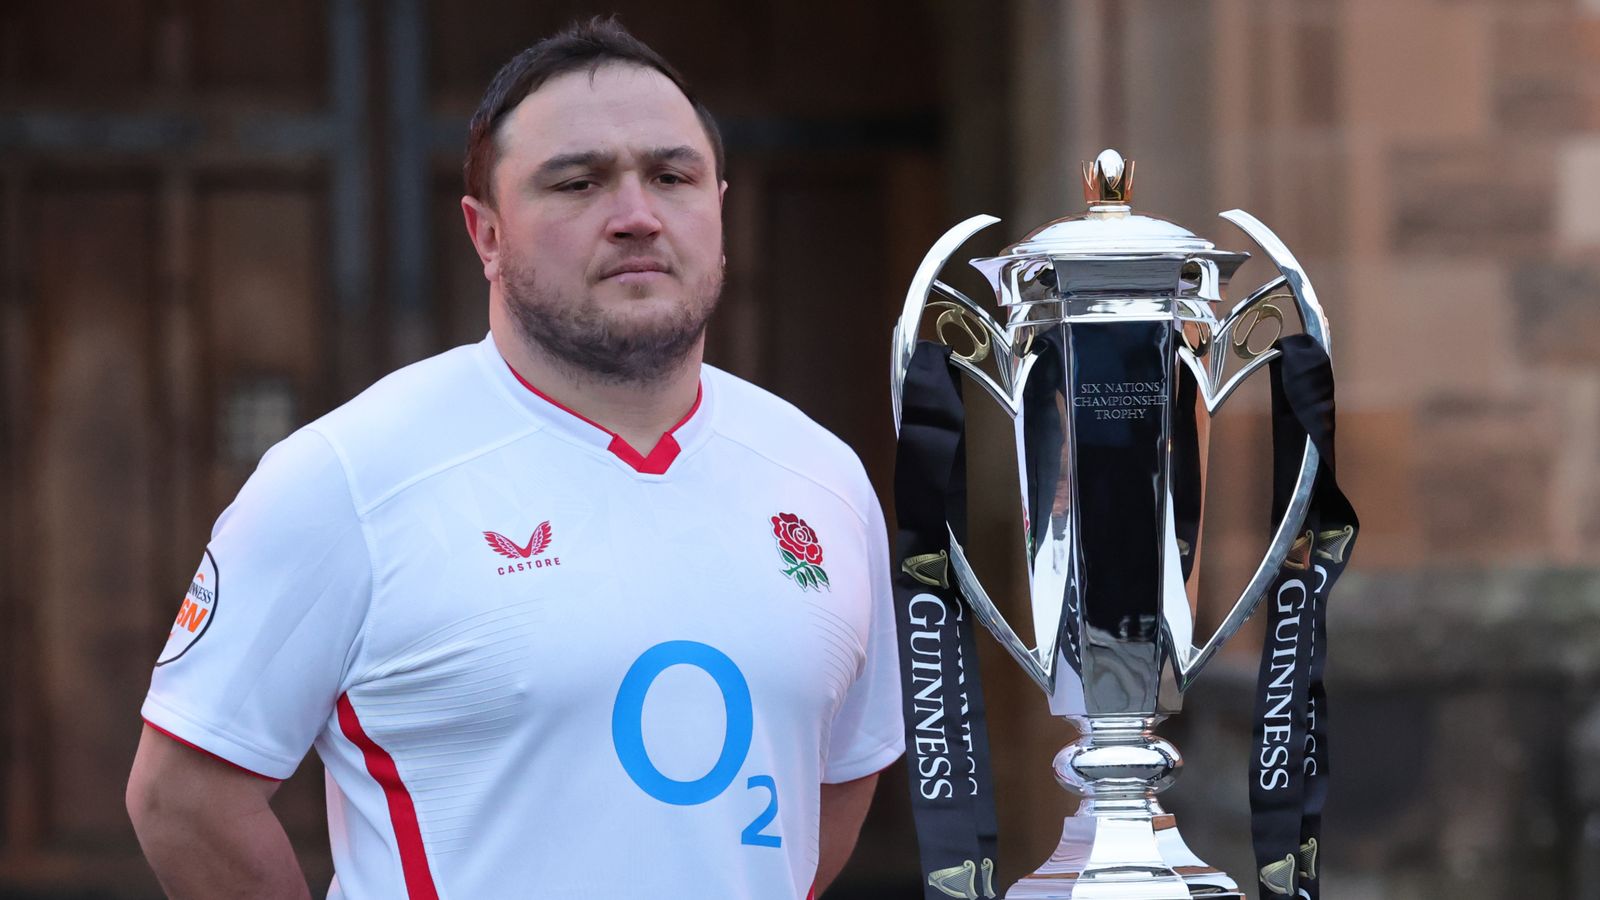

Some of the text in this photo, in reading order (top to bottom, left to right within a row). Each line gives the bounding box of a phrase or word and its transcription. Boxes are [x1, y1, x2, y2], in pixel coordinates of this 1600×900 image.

[1081, 382, 1160, 394] SIX NATIONS
[1073, 395, 1168, 407] CHAMPIONSHIP
[1094, 408, 1147, 420] TROPHY
[497, 557, 561, 576] CASTORE
[188, 582, 214, 604] NNESS
[1259, 578, 1307, 791] GUINNESS
[908, 592, 953, 800] GUINNESS
